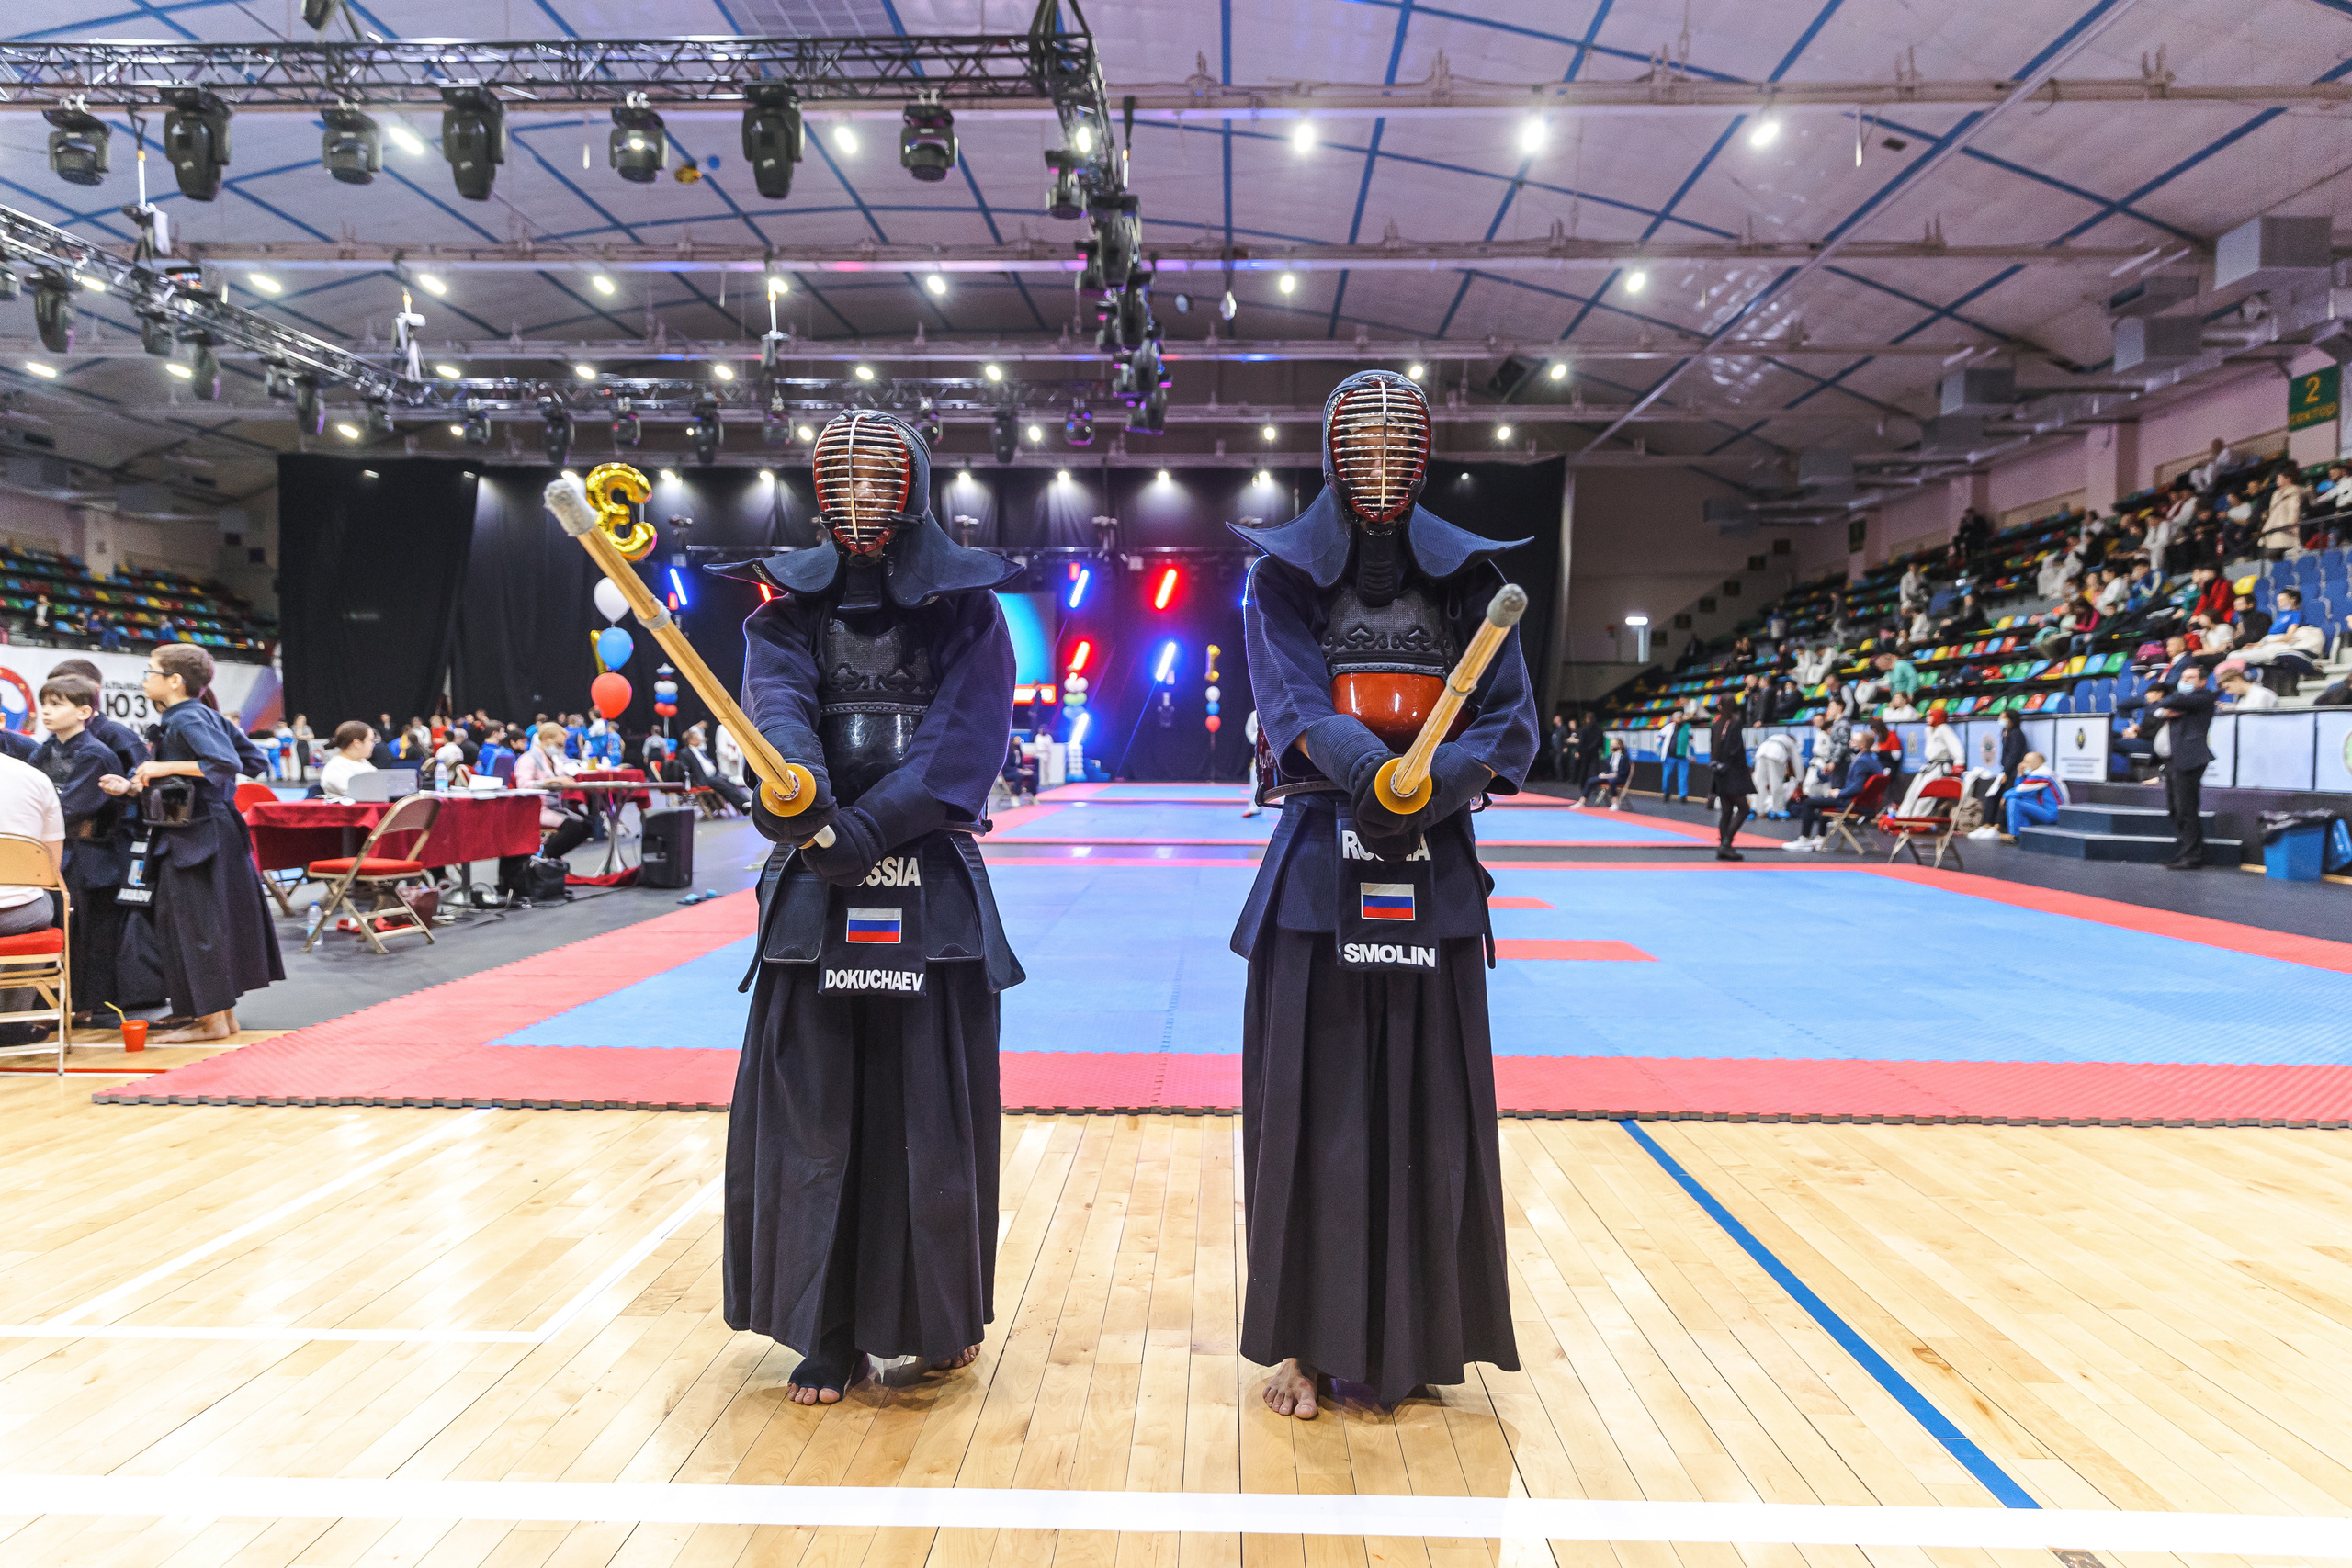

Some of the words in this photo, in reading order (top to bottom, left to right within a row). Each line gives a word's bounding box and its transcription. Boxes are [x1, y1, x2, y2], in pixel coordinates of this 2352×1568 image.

[2305, 376, 2320, 403] 2
[105, 694, 147, 718] ЮЗ
[856, 856, 922, 887] SSIA
[1343, 942, 1436, 968] SMOLIN
[824, 968, 924, 993] DOKUCHAEV
